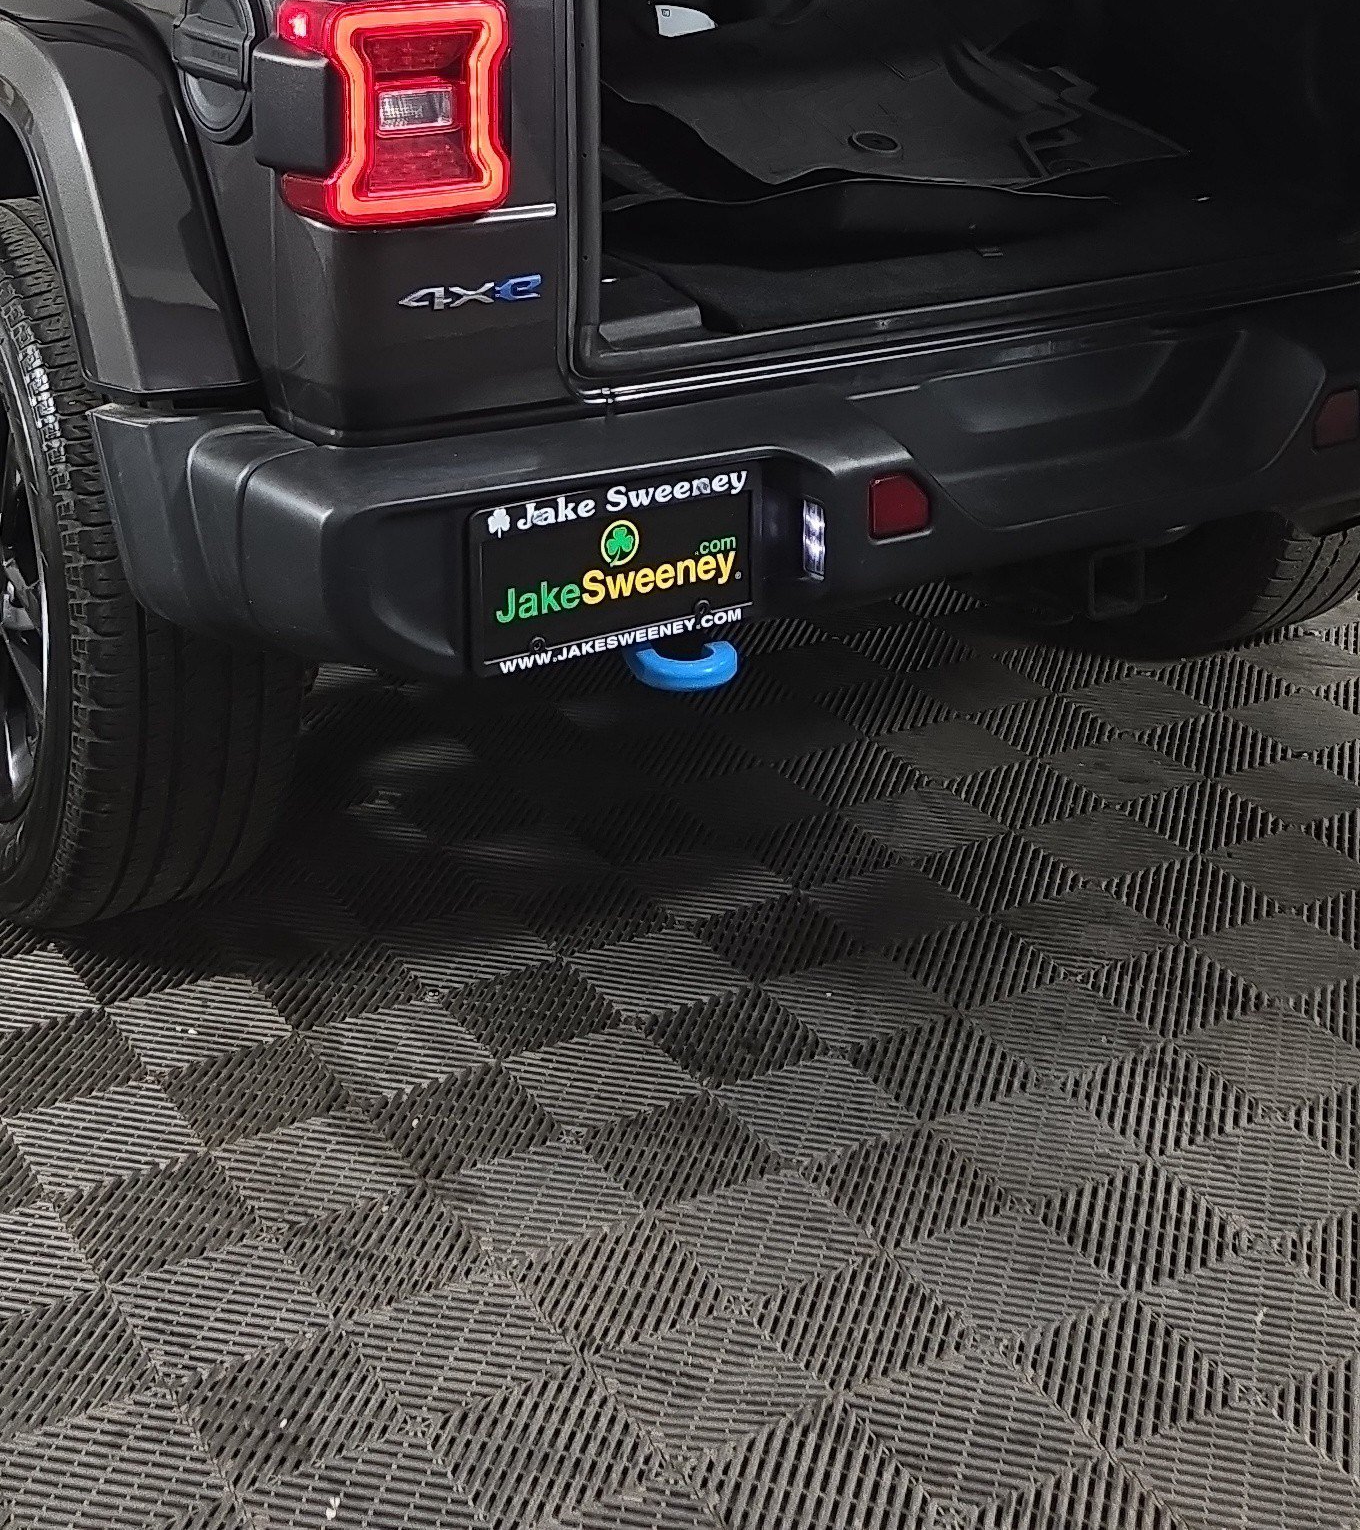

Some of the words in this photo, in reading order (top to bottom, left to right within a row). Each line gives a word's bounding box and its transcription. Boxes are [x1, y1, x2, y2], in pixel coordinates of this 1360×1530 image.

[516, 496, 596, 531] Jake
[605, 469, 748, 513] Sweeney
[498, 607, 742, 674] WWW.JAKESWEENEY.COM
